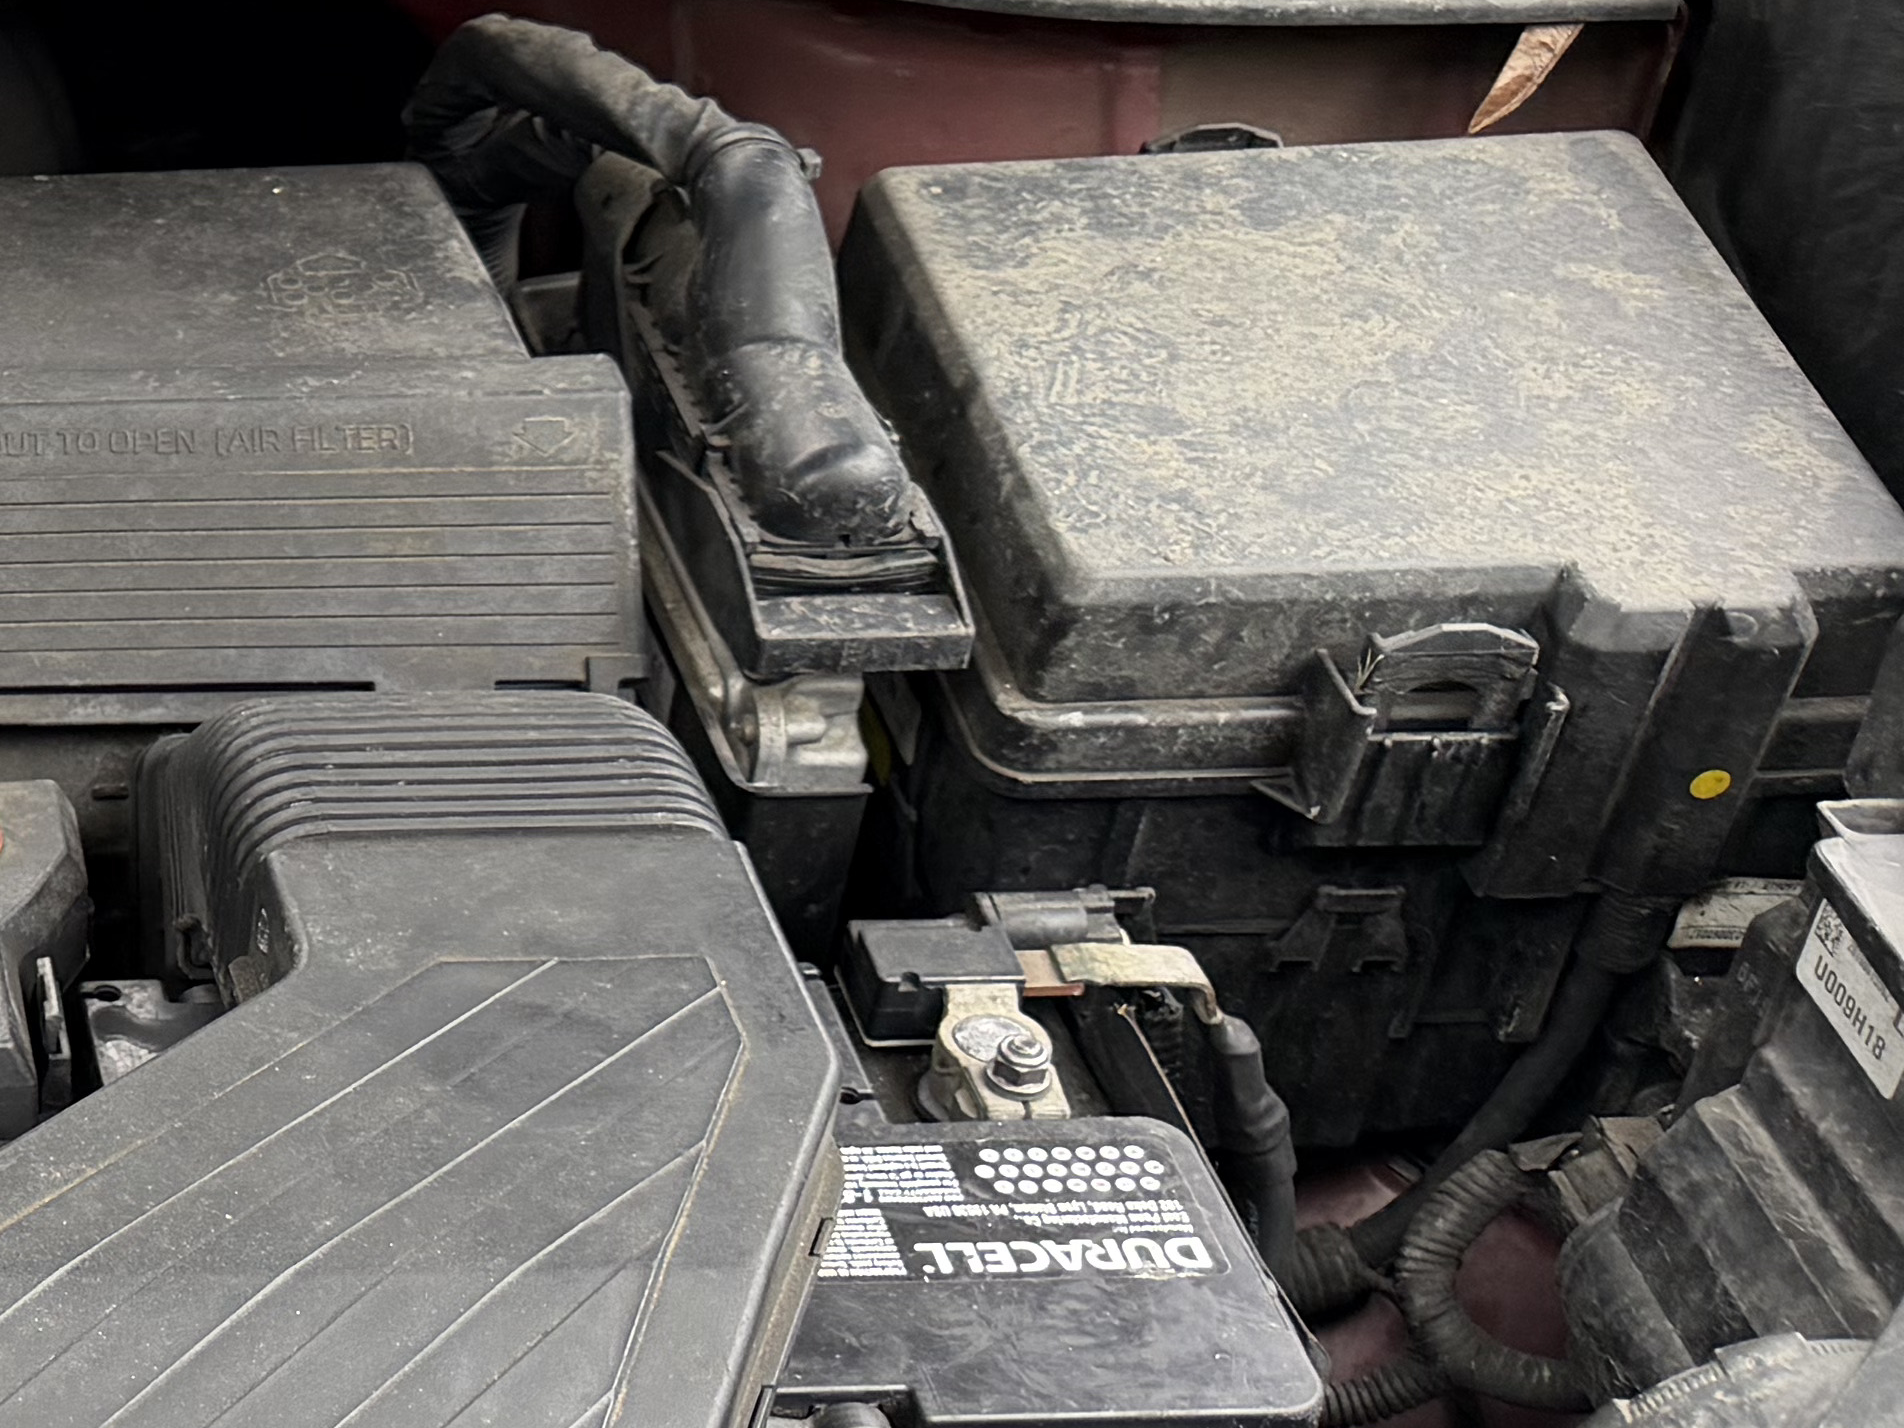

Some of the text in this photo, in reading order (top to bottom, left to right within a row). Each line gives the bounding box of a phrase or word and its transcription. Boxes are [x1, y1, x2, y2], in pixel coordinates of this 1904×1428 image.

[54, 431, 100, 456] TO
[107, 429, 195, 456] OPEN
[1813, 954, 1887, 1061] U009H18
[913, 1236, 1212, 1274] DURACELL
